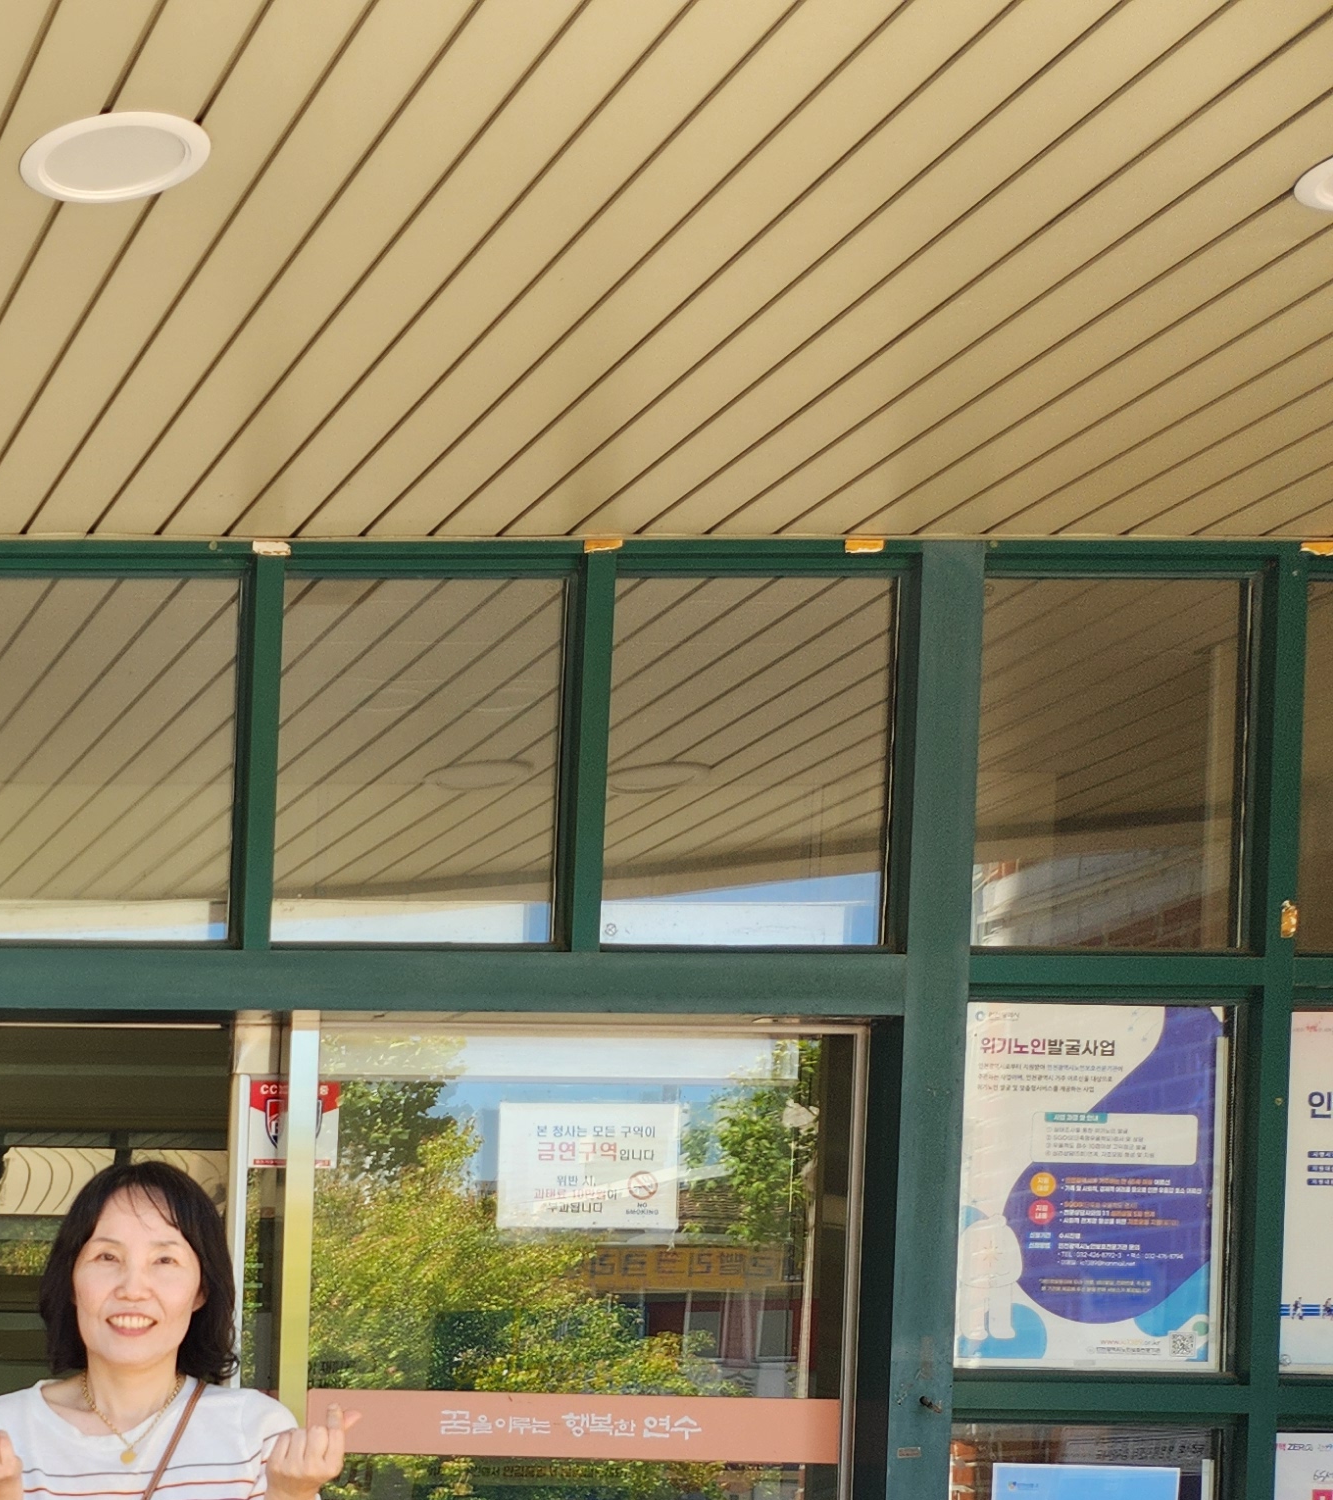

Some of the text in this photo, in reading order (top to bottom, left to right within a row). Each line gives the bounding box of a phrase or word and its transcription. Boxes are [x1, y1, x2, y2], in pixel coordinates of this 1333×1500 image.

[980, 1036, 1117, 1058] 위기노인발굴사업
[536, 1125, 656, 1139] 본 청사는 모든 구역이
[556, 1174, 579, 1187] 위반
[545, 1201, 604, 1214] 부과됩니다
[560, 1411, 637, 1438] 행복한
[642, 1414, 703, 1440] 연수
